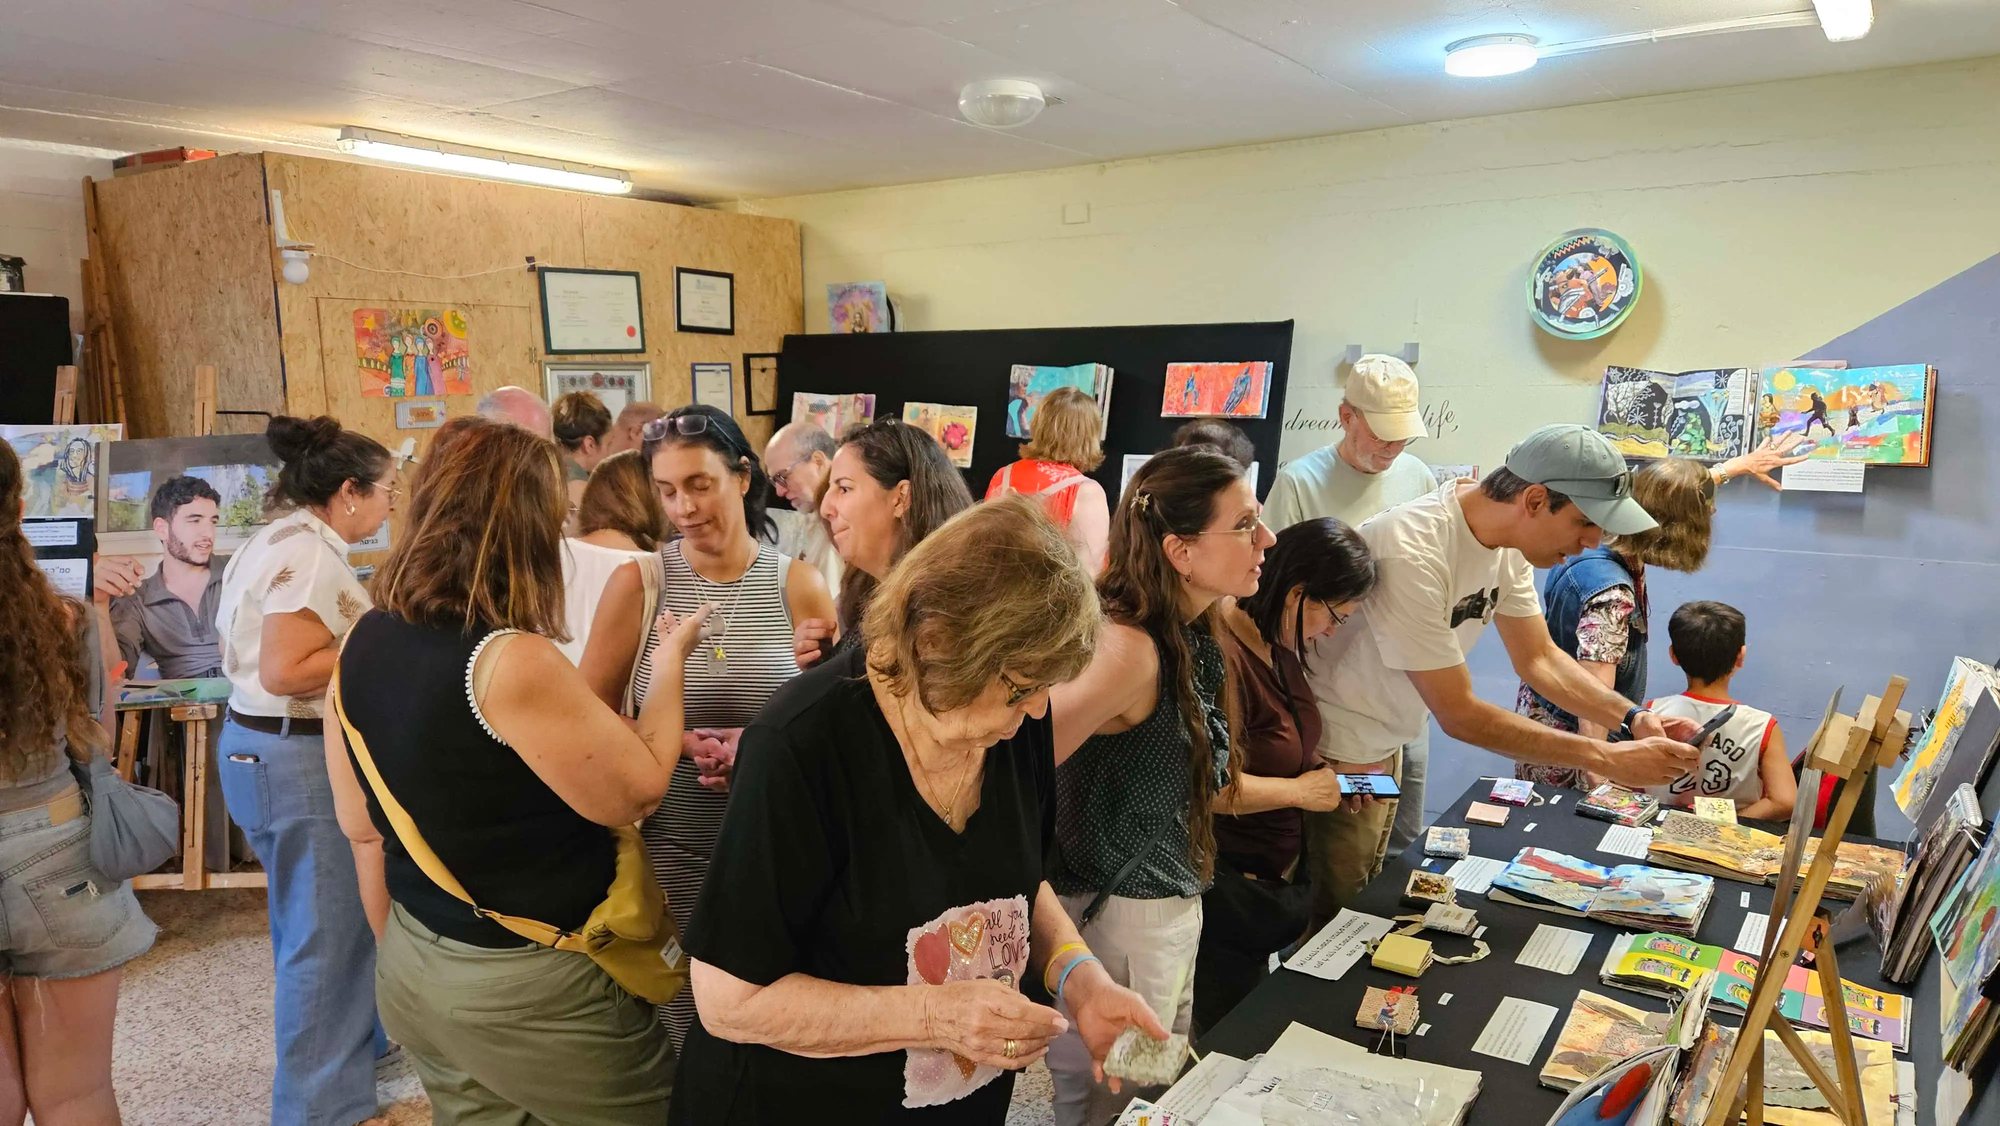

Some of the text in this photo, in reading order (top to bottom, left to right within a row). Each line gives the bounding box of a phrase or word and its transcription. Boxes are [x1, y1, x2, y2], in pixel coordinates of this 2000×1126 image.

[983, 909, 1003, 930] all
[990, 924, 1016, 946] need
[987, 936, 1026, 970] LOVE
